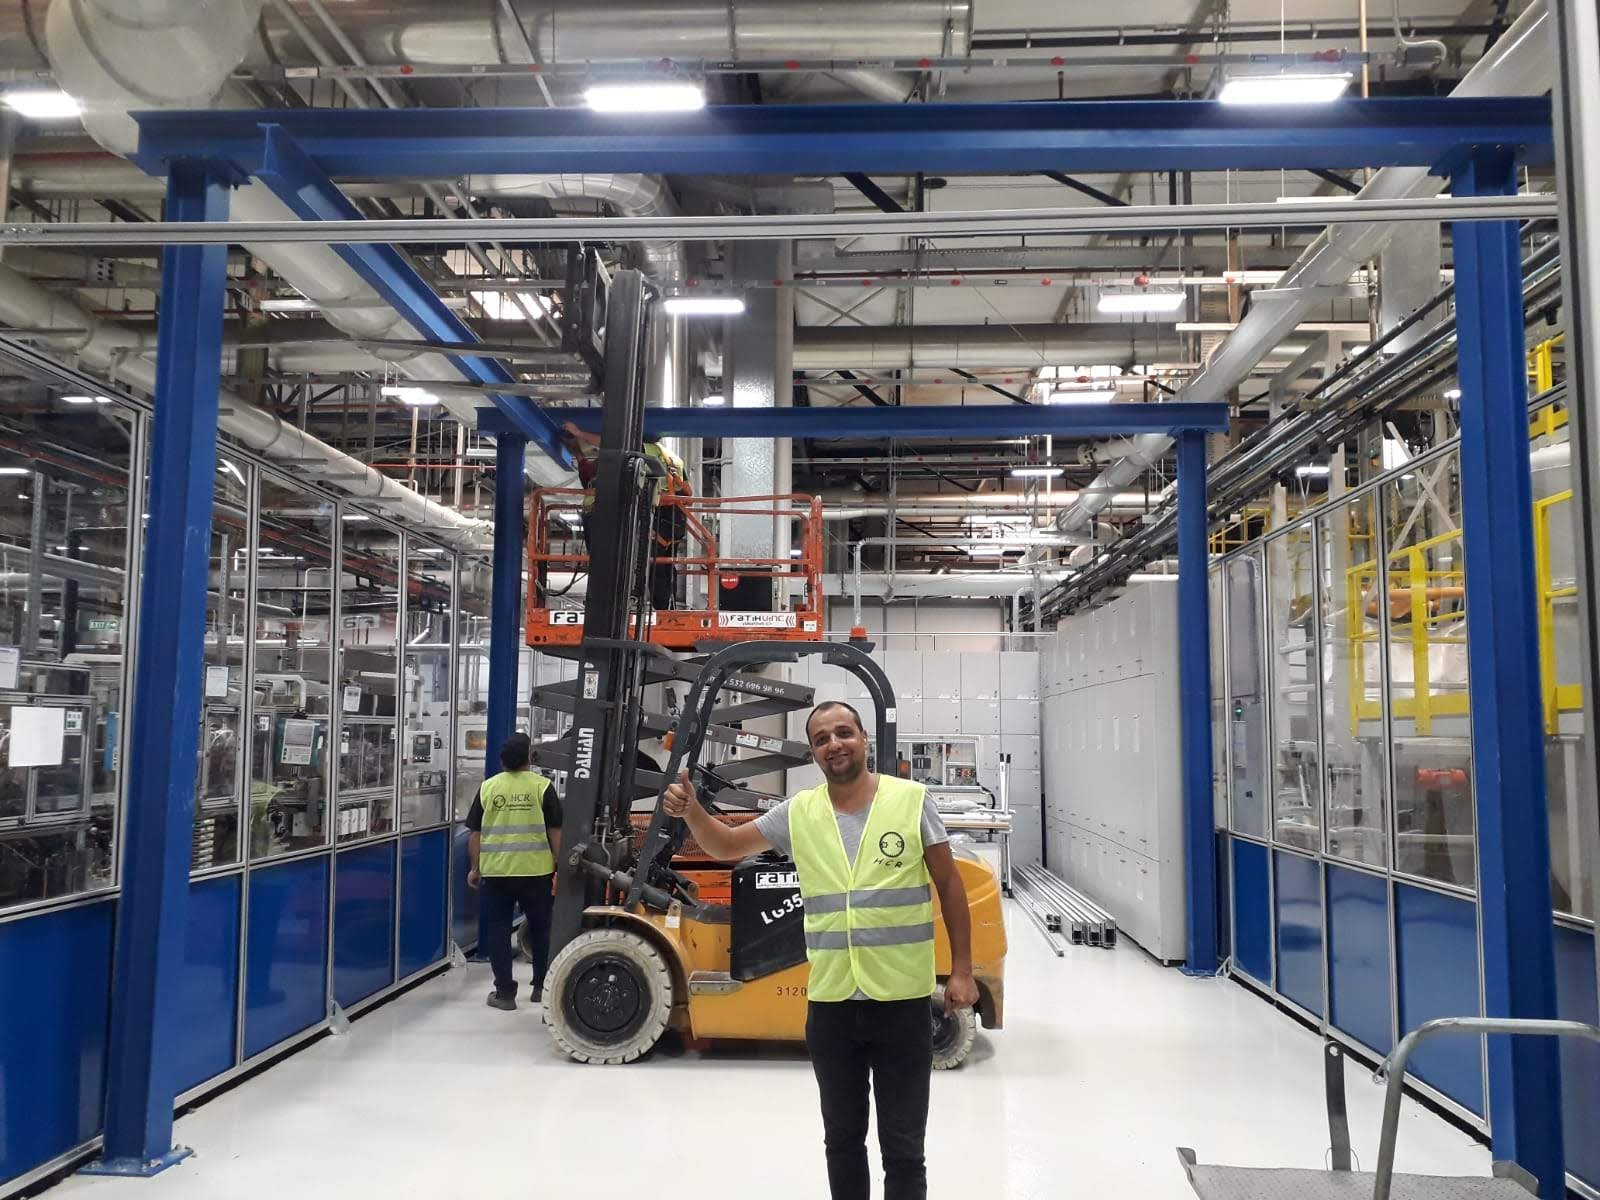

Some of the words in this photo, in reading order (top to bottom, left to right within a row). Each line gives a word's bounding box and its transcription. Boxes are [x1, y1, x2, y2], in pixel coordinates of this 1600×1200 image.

[873, 858, 903, 868] HCR
[760, 893, 804, 925] LG35
[776, 986, 807, 997] 3120
